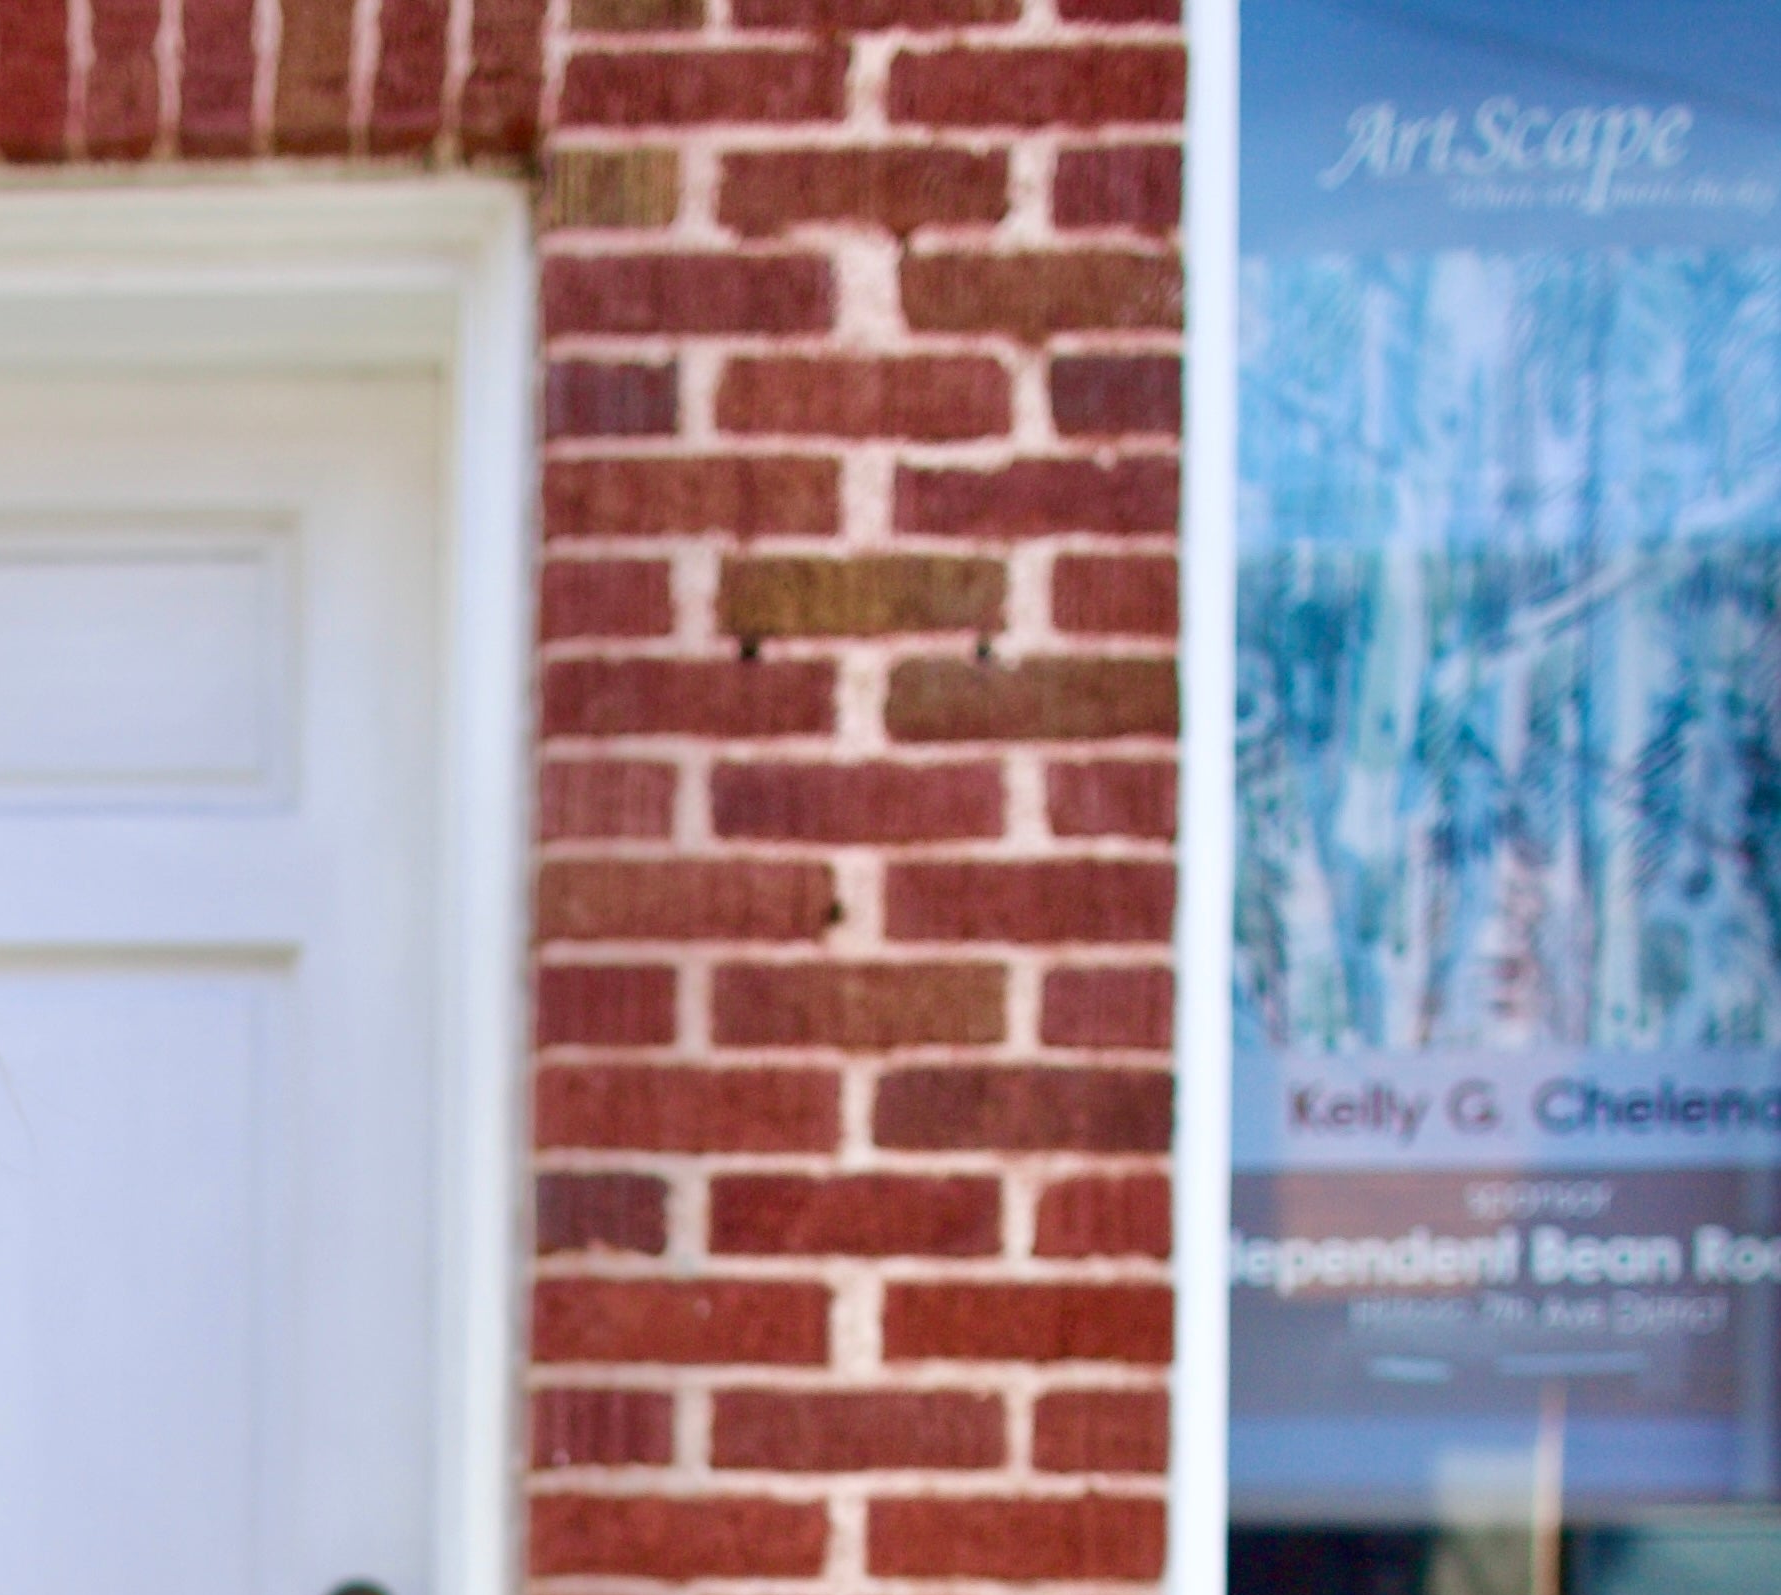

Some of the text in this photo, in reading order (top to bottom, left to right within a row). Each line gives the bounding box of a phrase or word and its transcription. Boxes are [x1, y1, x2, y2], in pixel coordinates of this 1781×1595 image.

[1318, 97, 1694, 215] ArtScape
[1285, 1080, 1431, 1146] Kelly
[1530, 1225, 1682, 1284] Bean
